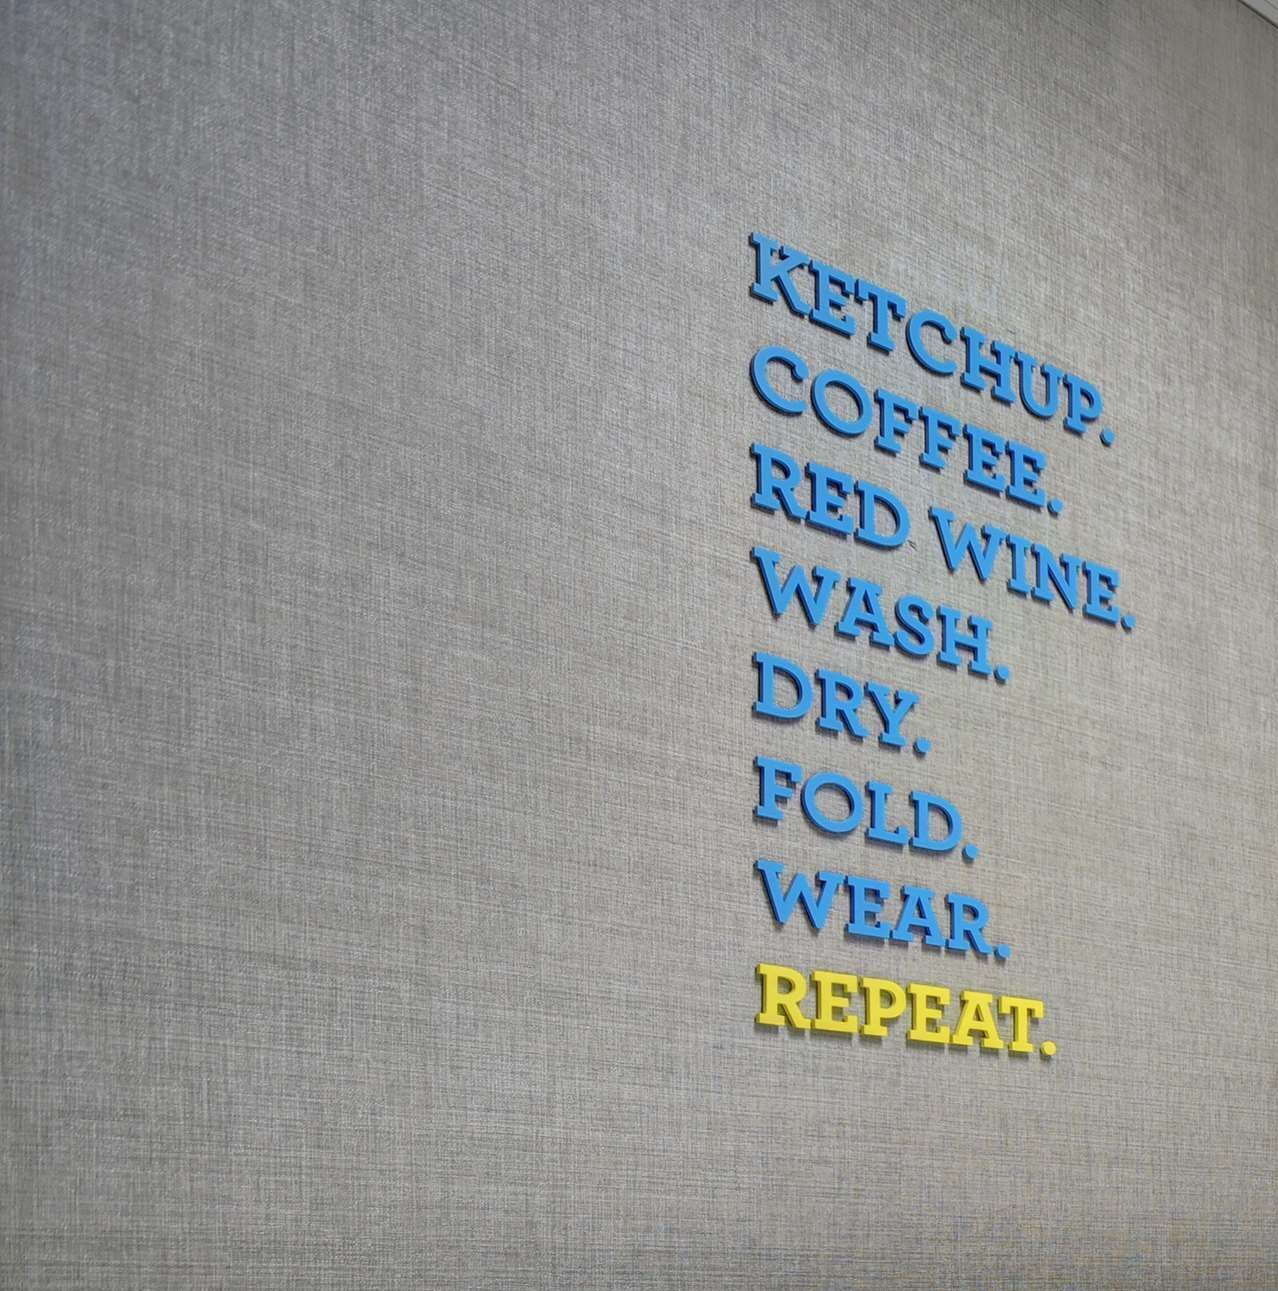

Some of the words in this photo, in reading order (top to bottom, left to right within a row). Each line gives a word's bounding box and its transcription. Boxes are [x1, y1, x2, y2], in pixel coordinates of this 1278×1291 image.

[749, 231, 1115, 447] KETCHUP.
[750, 345, 1064, 514] COFFEE.
[750, 443, 911, 551] RED
[928, 506, 1136, 631] WINE.
[751, 546, 1010, 683] WASH.
[752, 651, 931, 756] DRY.
[753, 756, 978, 860] FOLD.
[753, 859, 1011, 960] WEAR.
[755, 963, 1057, 1058] REPEAT.
